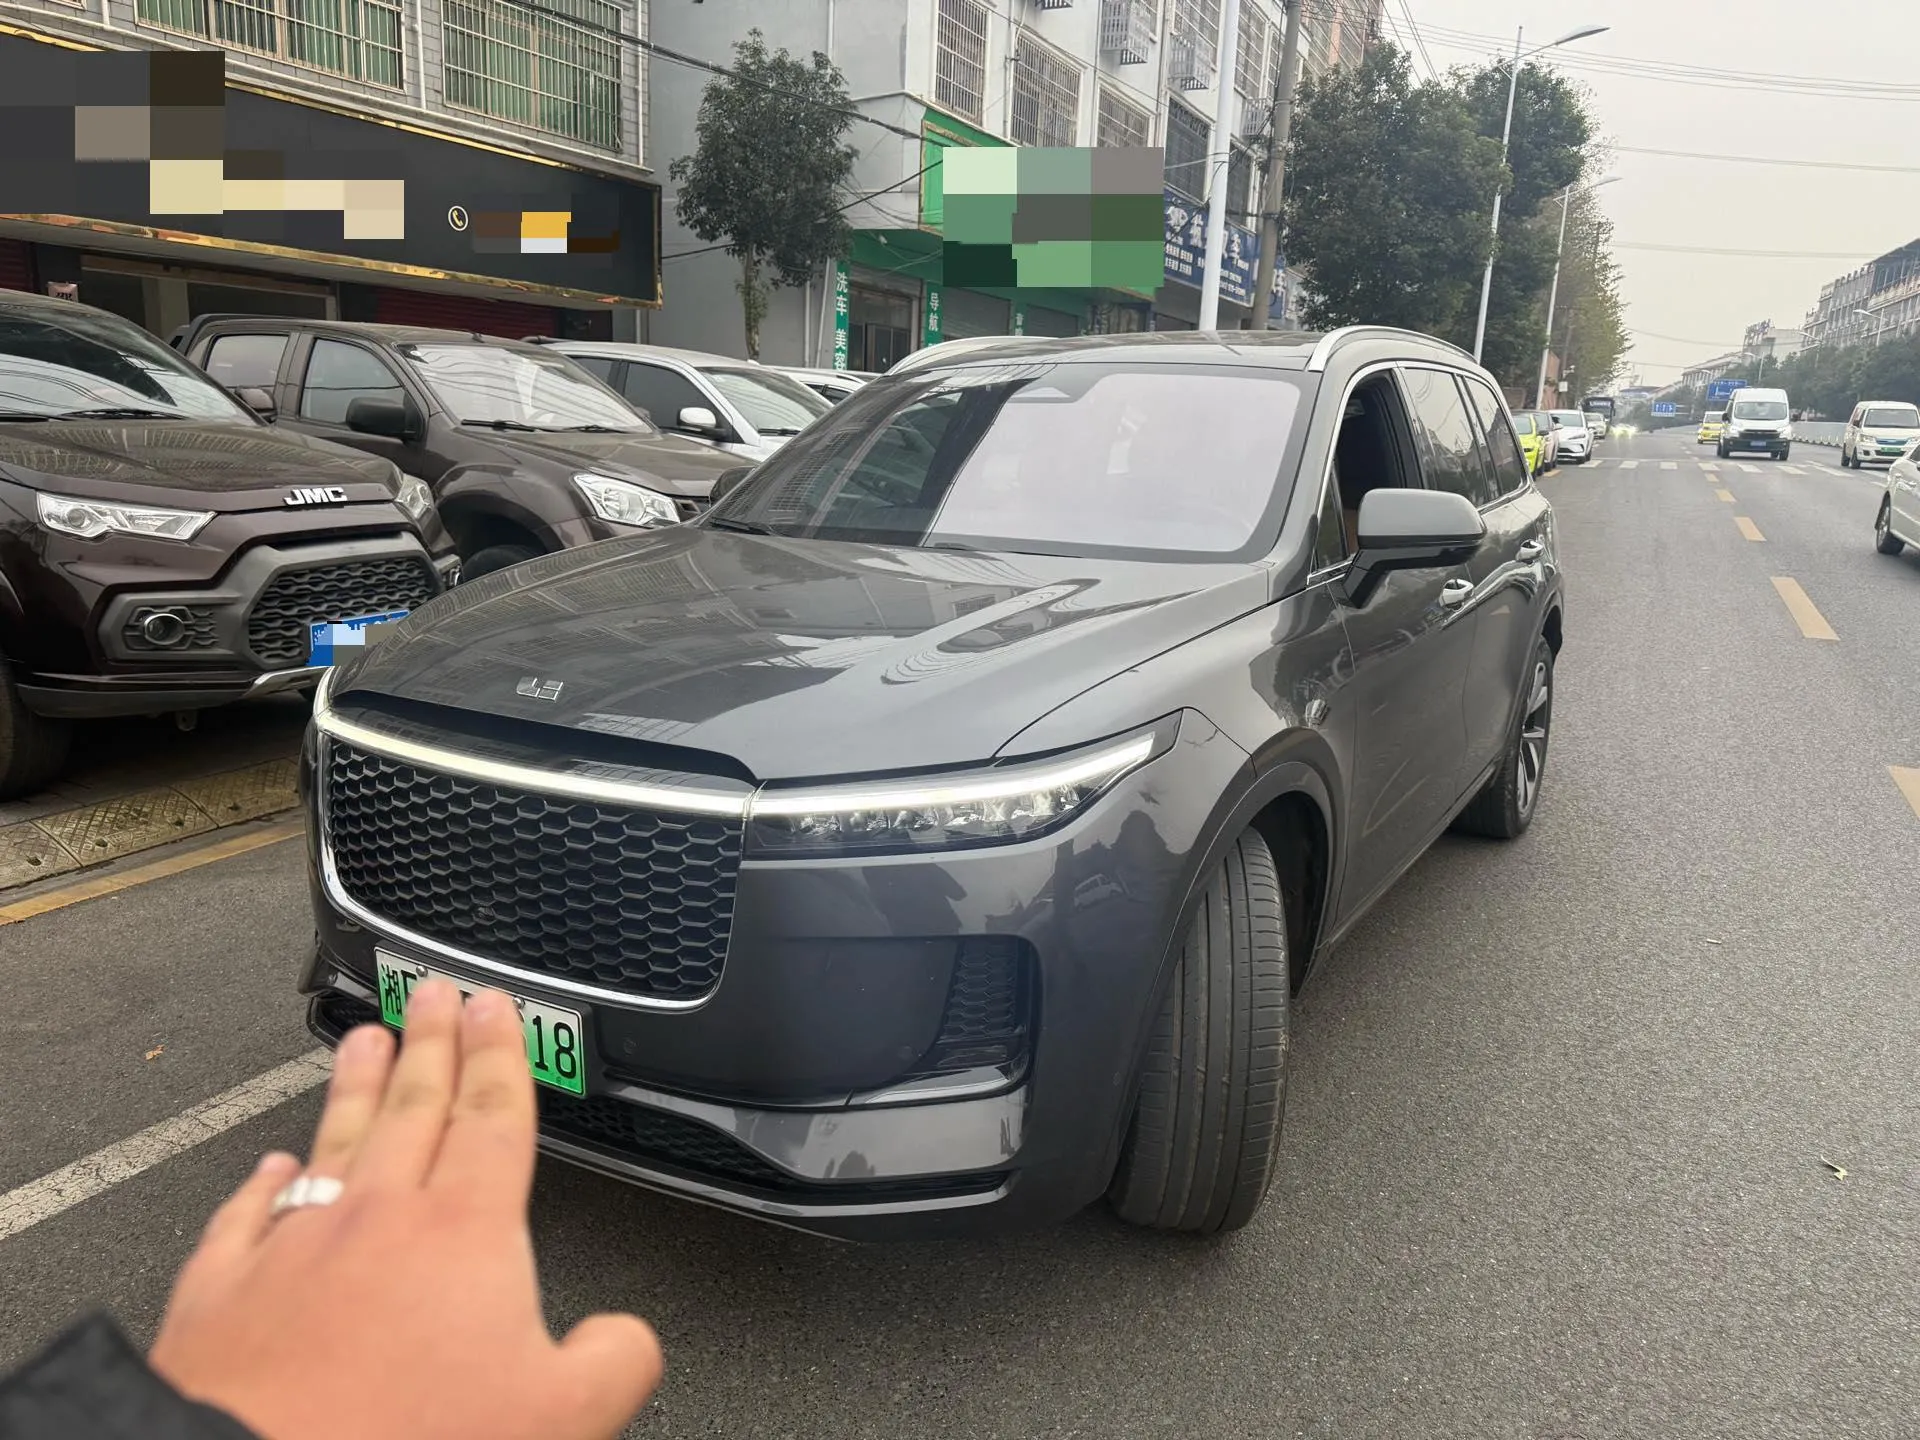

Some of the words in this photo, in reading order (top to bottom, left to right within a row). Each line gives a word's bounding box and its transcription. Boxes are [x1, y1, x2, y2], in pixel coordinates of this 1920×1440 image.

[836, 271, 848, 316] 洗车
[928, 292, 939, 332] 导航
[834, 328, 847, 371] 美容
[284, 486, 348, 506] JMC
